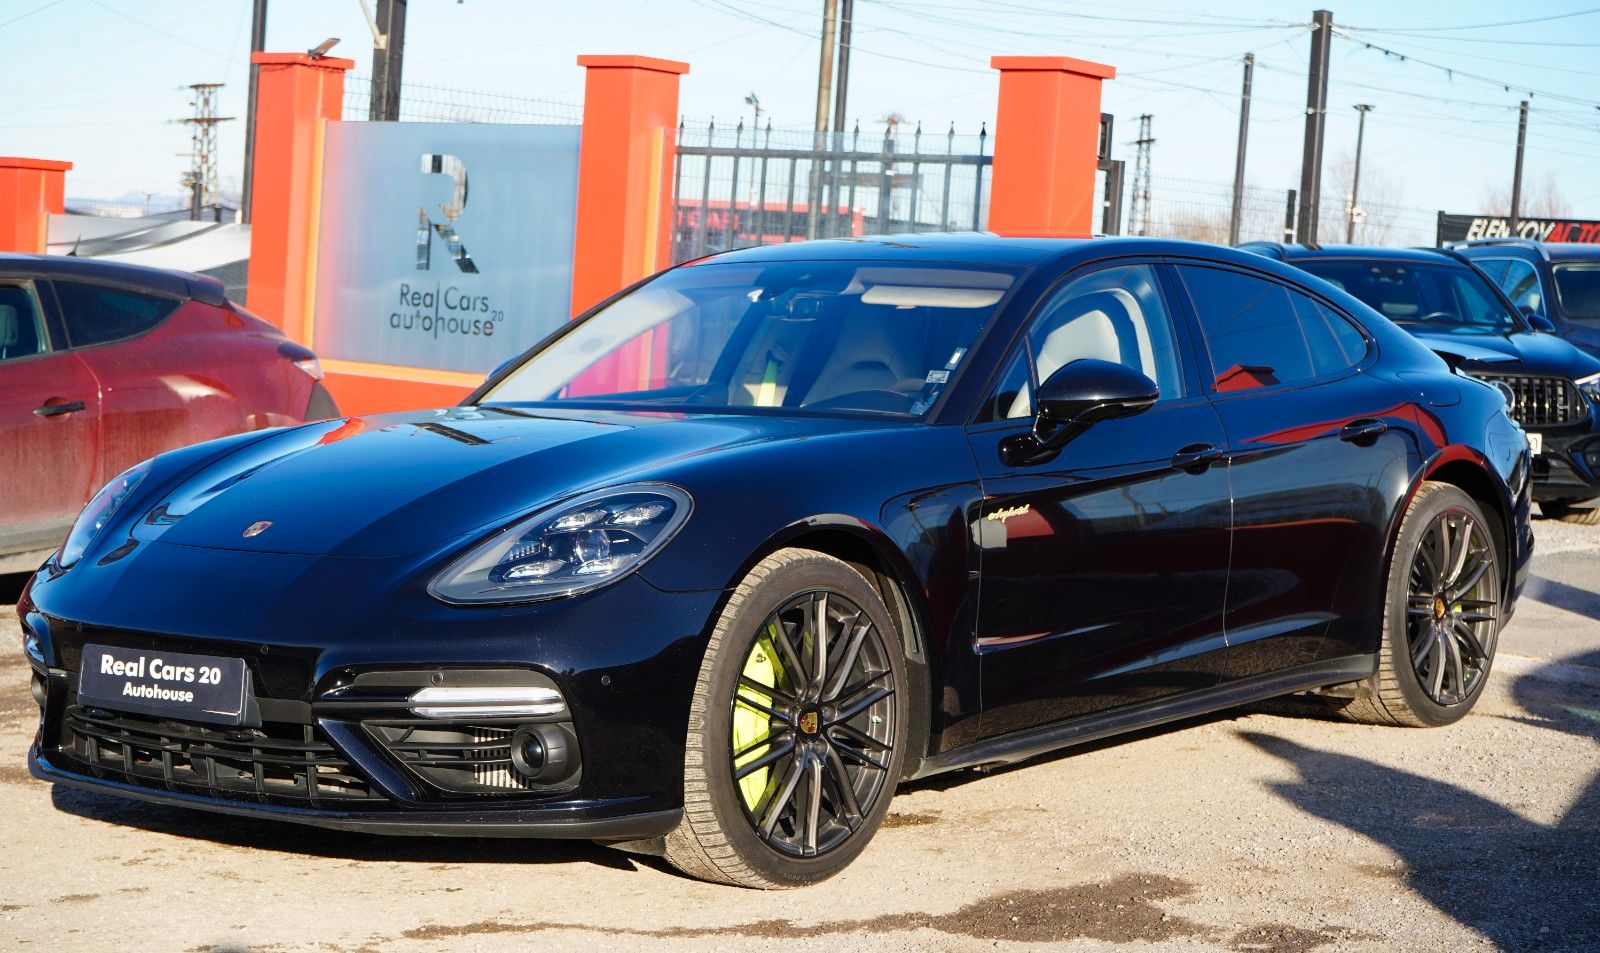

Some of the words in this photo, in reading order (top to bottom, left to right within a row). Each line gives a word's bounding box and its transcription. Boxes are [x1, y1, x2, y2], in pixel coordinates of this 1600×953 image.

[416, 153, 480, 274] R
[399, 281, 440, 309] Real
[444, 286, 490, 313] Cars
[390, 309, 494, 339] autohouse
[100, 654, 145, 678] Real
[149, 658, 195, 683] Cars
[198, 666, 221, 685] 20
[122, 681, 194, 702] Autohouse
